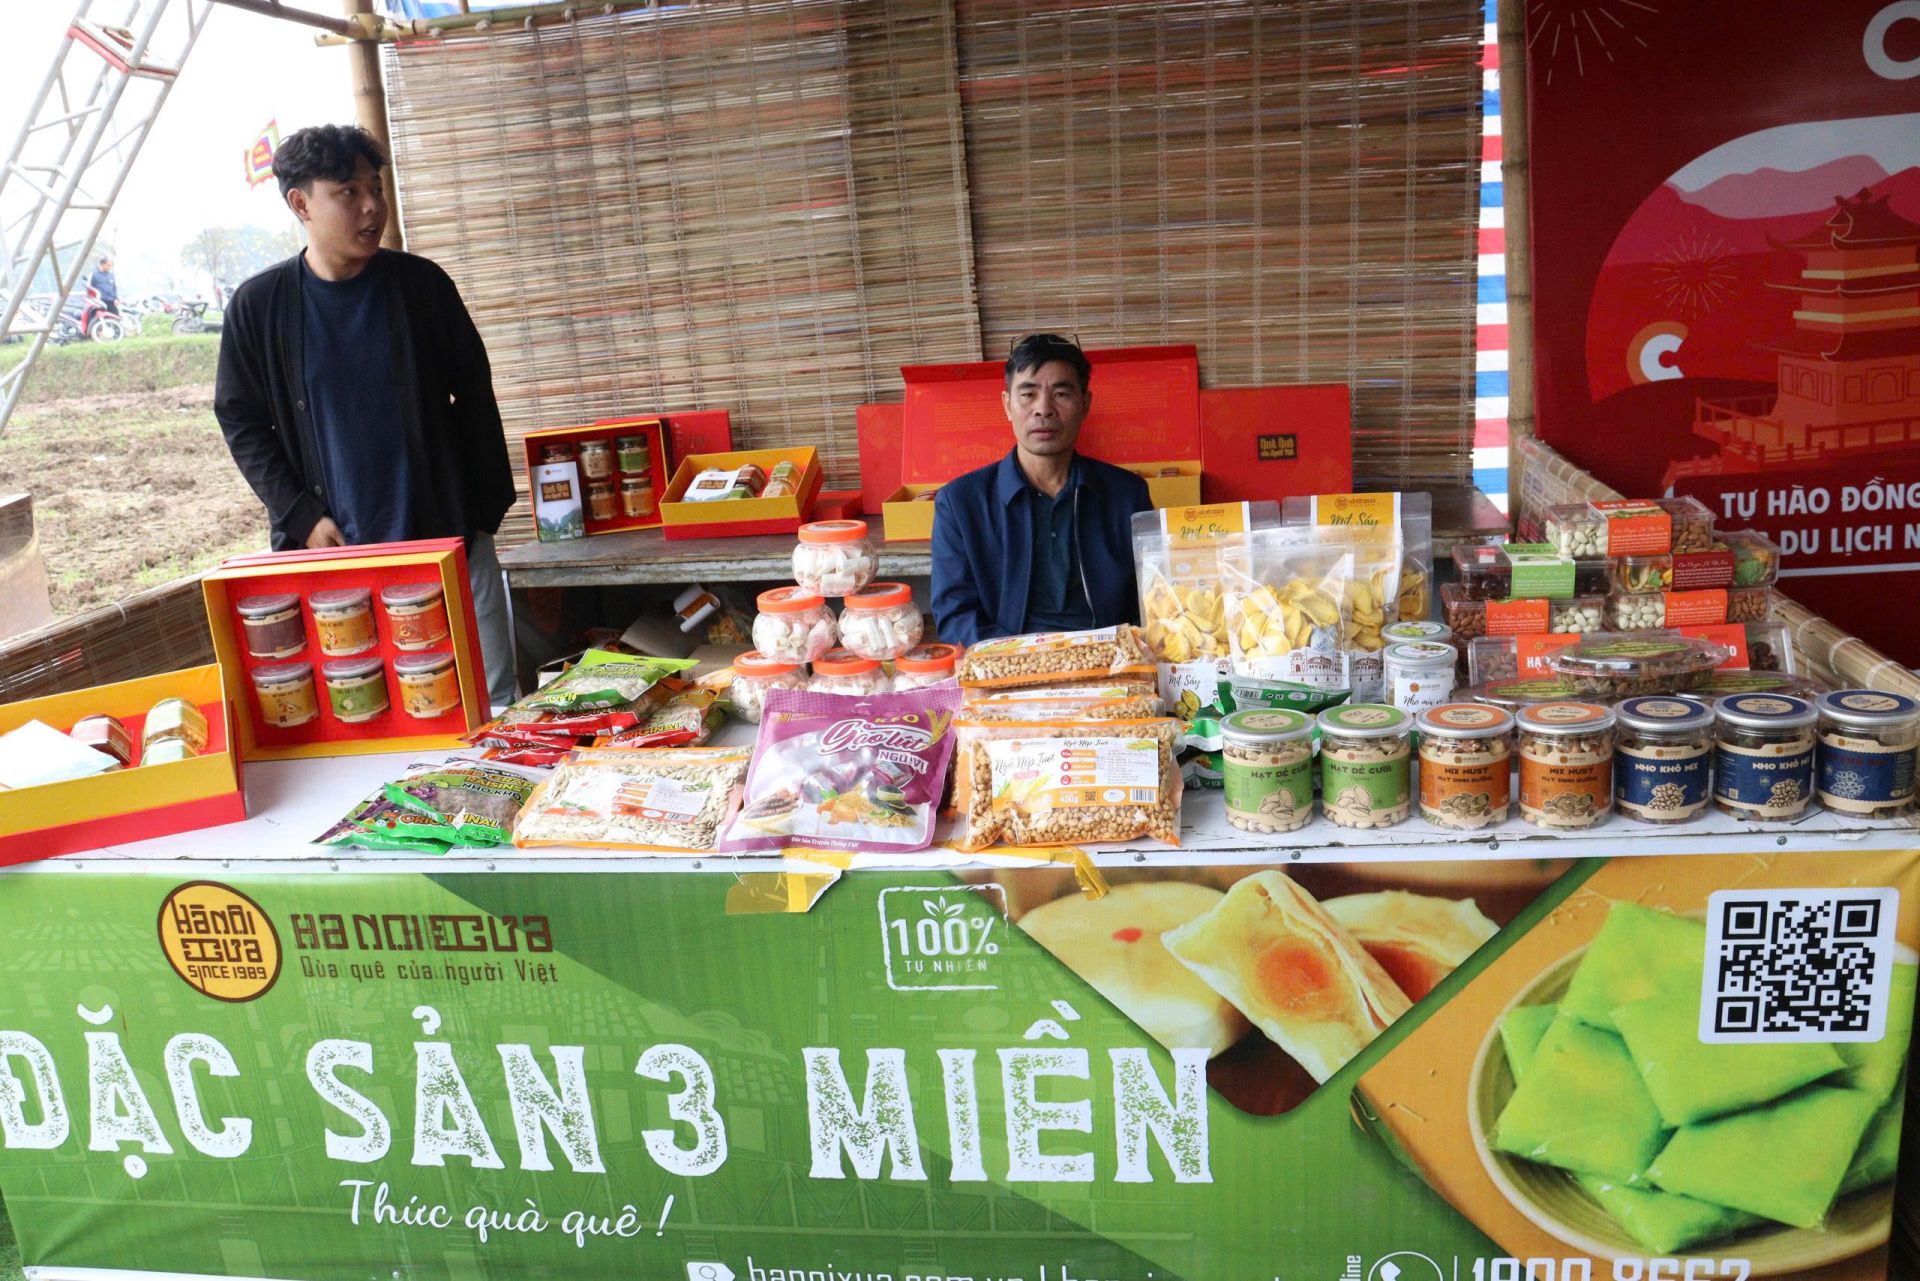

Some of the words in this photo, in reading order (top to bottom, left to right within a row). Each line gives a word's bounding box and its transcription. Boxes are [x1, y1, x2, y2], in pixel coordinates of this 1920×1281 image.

[1720, 489, 1758, 520] TỰ
[1767, 484, 1830, 516] HÀO
[1780, 529, 1820, 555] DU
[1830, 525, 1893, 556] LỊCH
[1445, 767, 1460, 775] MIX
[1549, 767, 1565, 775] MIX
[1635, 763, 1656, 772] NHO
[1659, 762, 1682, 773] KHÔ
[1752, 762, 1776, 771] NHO
[891, 917, 999, 956] 100%
[187, 965, 231, 979] SINCE
[232, 966, 268, 980] 1989
[351, 961, 385, 983] quê
[397, 960, 433, 980] của
[445, 958, 505, 986] người
[515, 959, 559, 985] Việt
[0, 1003, 252, 1179] ĐẶC
[305, 1005, 606, 1174] SẢN
[635, 1043, 728, 1177] 3
[801, 1000, 1214, 1184] MIỀN
[339, 1179, 452, 1228] Thức
[465, 1198, 549, 1244] quà
[561, 1204, 642, 1249] quê
